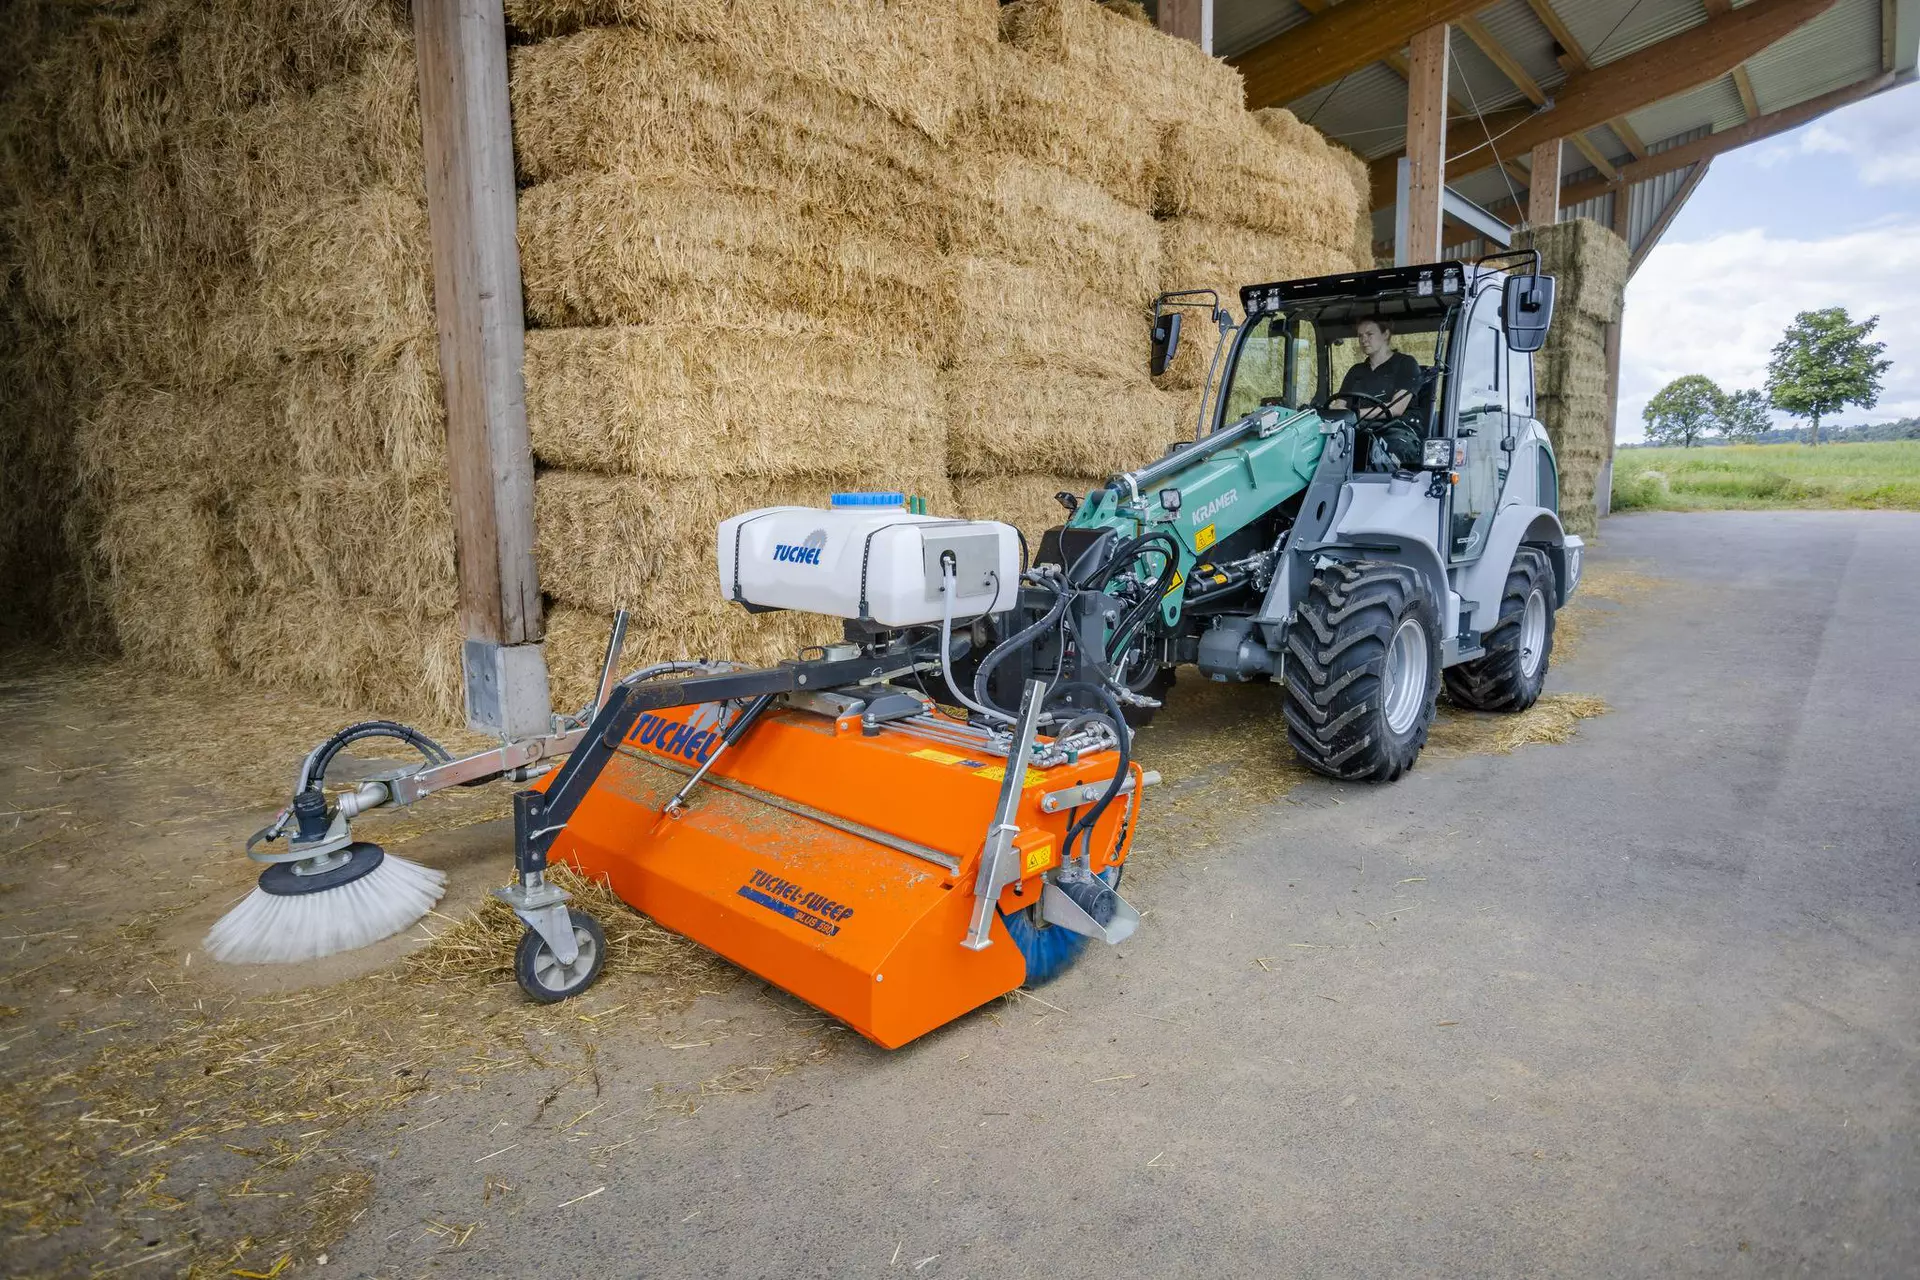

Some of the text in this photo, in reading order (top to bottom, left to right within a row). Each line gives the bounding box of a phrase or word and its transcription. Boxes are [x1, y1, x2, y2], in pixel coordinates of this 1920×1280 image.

[1191, 488, 1238, 526] KRAMER
[773, 544, 821, 566] TUCHEL
[630, 713, 718, 764] TUCHEL
[749, 868, 854, 922] TUCHEL-SWEEP
[794, 911, 818, 927] PLUS
